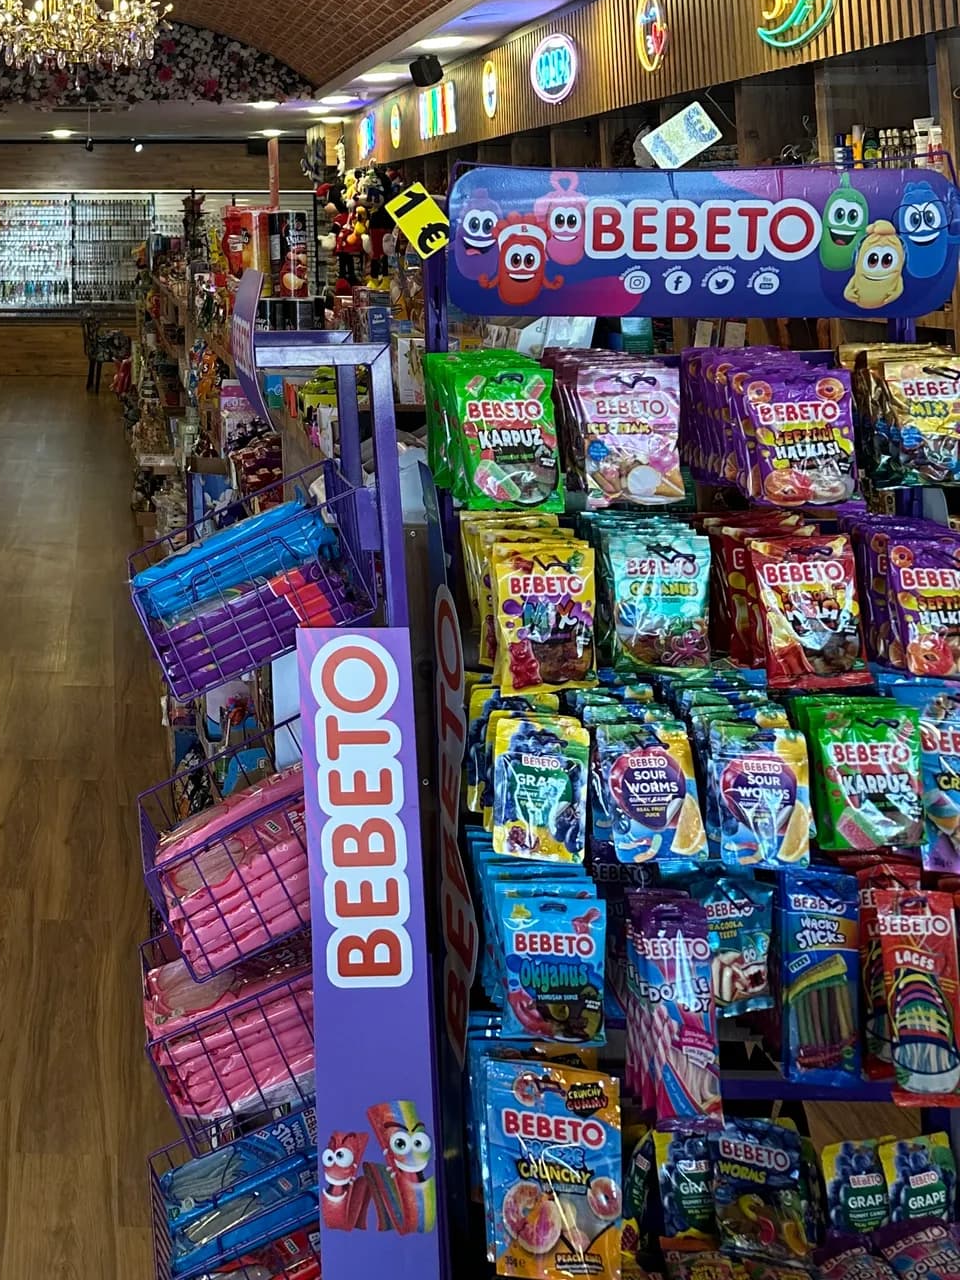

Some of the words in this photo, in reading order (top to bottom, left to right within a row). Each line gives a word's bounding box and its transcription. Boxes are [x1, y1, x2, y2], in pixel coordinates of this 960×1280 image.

[591, 205, 815, 254] BEBETO
[903, 380, 959, 397] BEBET
[468, 400, 542, 420] BEBETO
[596, 398, 667, 416] BEBETO
[759, 401, 839, 424] BEBETO
[478, 427, 544, 448] KARPUZ
[626, 558, 699, 576] BEBETO
[764, 561, 845, 585] BEBETO
[509, 576, 584, 595] BEBETO
[901, 567, 960, 589] BEBET
[920, 729, 960, 753] BEB
[522, 755, 560, 769] BEBETO
[629, 756, 667, 768] BEBETO
[833, 744, 910, 762] BEBETO
[633, 770, 668, 781] SOUR
[743, 761, 782, 773] BEBETO
[628, 781, 679, 793] WORMS
[747, 775, 781, 786] SOUR
[842, 774, 912, 795] KARPUZ
[739, 786, 791, 800] WORMS
[321, 645, 402, 977] BEBETO
[436, 597, 476, 1054] BEBETO
[706, 899, 753, 918] BEBEO
[792, 896, 846, 914] BEBEO
[800, 917, 840, 932] WACKY
[879, 917, 950, 935] BEBETO
[514, 933, 594, 956] BEBETO
[795, 929, 846, 949] STICKS
[894, 951, 935, 970] LACES
[521, 959, 588, 993] Okyanus
[567, 1086, 602, 1100] CRUNCHY
[504, 1109, 605, 1147] BEBETO
[721, 1140, 789, 1170] BEBETO
[519, 1162, 591, 1185] CRUNCHY
[717, 1160, 767, 1184] WORMS
[850, 1173, 882, 1188] BEBETO
[909, 1171, 938, 1188] BEBETO
[908, 1190, 947, 1210] GRAPE
